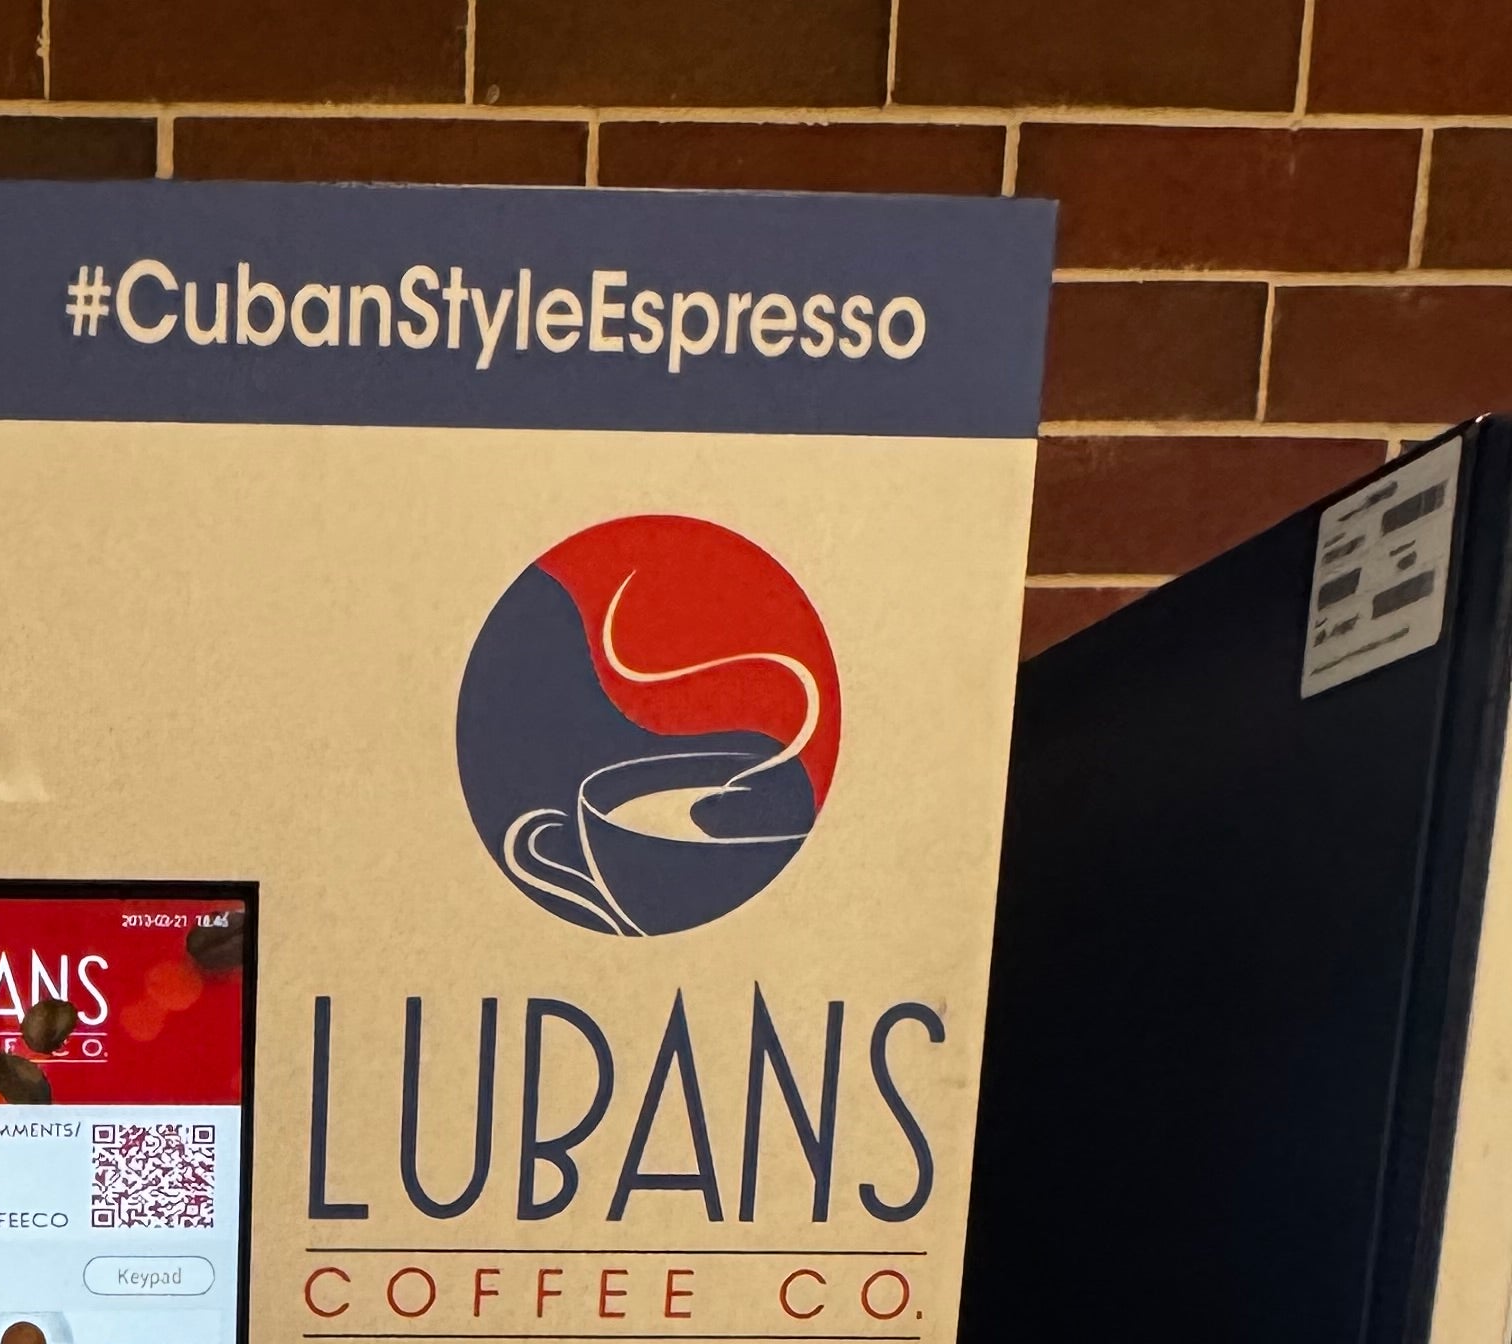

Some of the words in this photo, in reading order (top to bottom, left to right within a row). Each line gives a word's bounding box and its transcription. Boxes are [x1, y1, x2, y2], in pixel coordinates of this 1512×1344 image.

[66, 258, 926, 373] #CubanStyleEspresso
[308, 980, 946, 1222] LUBANS
[117, 1266, 183, 1287] Keypad
[304, 1266, 695, 1320] COFFEE
[779, 1268, 924, 1320] CO.
